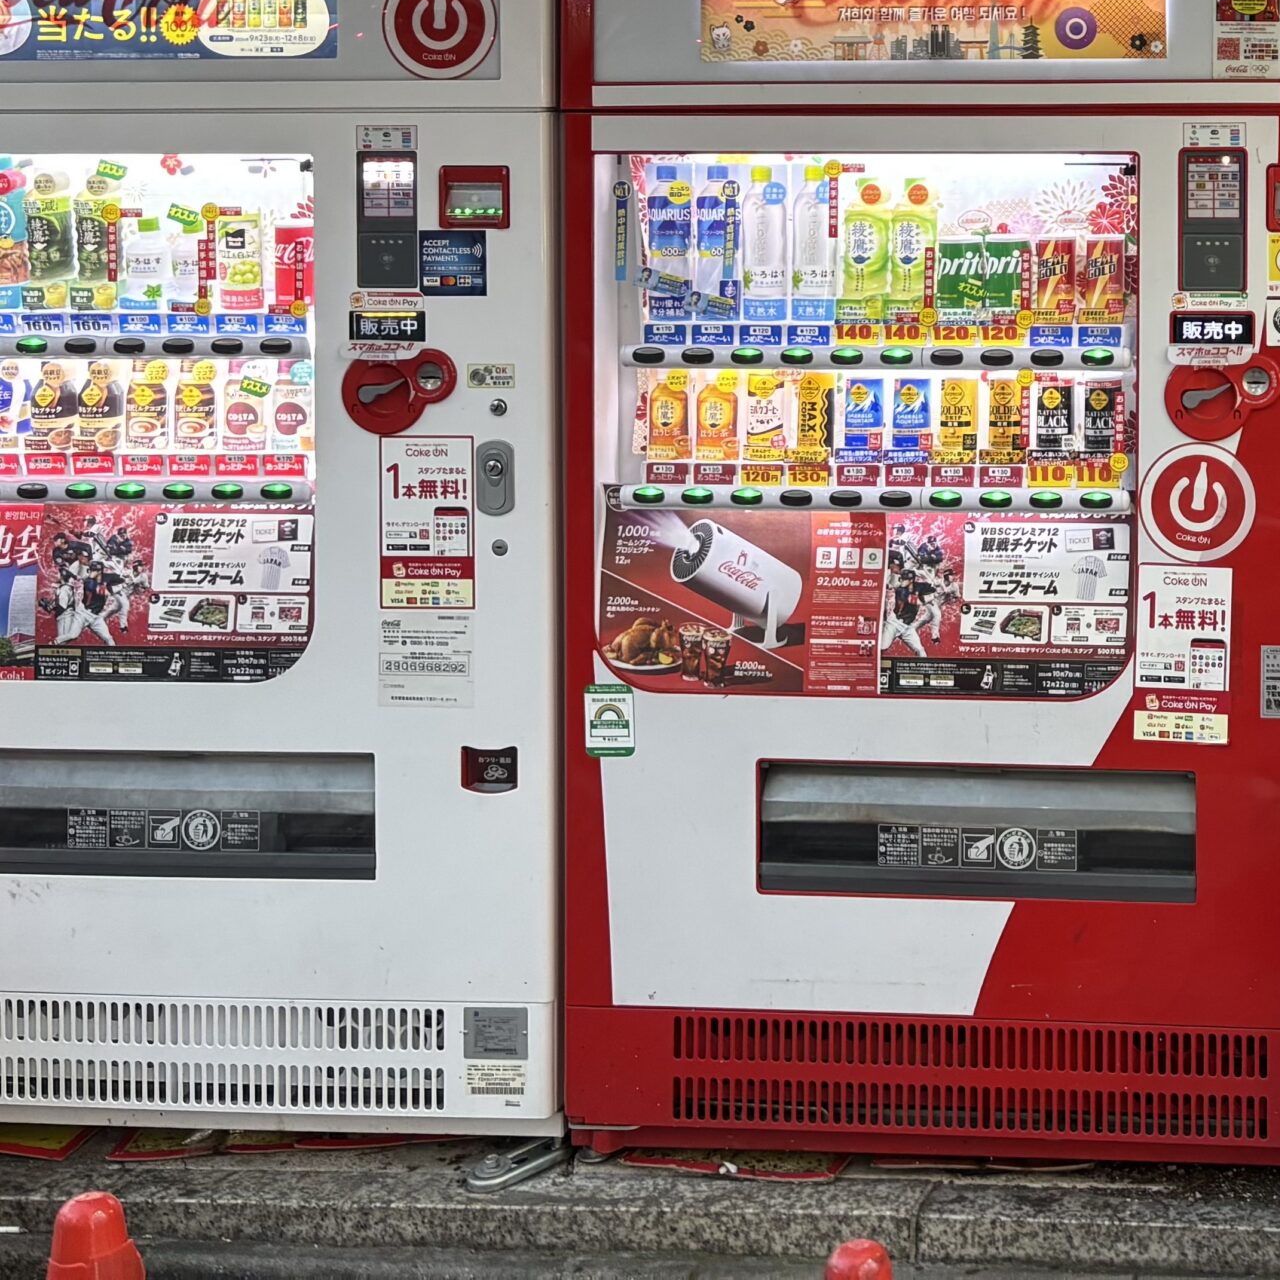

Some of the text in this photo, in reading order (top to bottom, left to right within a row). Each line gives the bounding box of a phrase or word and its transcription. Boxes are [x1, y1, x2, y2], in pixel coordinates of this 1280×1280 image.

[837, 8, 876, 22] 저희와
[878, 8, 905, 22] 함께
[909, 8, 948, 22] 즐거운
[951, 8, 976, 22] 여행
[37, 5, 157, 42] 当たる!!
[422, 52, 444, 61] Coke
[851, 222, 869, 255] 綾鷹
[898, 222, 916, 255] 綾鷹
[1039, 255, 1067, 271] REAL
[1088, 255, 1116, 270] REAL
[1039, 264, 1068, 280] GOLD
[1088, 264, 1116, 280] GOLD
[367, 298, 388, 307] Coke
[402, 298, 418, 309] Pay
[1191, 299, 1209, 308] Coke
[1219, 299, 1232, 309] Pay
[25, 321, 60, 331] 160円
[72, 321, 110, 331] 160円
[360, 319, 418, 335] 販売中
[836, 325, 879, 340] 140円
[885, 325, 927, 340] 140円
[933, 325, 977, 340] 120円
[981, 325, 1025, 340] 120円
[1182, 321, 1243, 340] 販売中
[807, 401, 817, 433] MAX
[1038, 415, 1068, 428] BLACK
[653, 429, 681, 437] ほうじ茶
[701, 429, 729, 438] ほうじ茶
[405, 448, 432, 457] Coke
[386, 463, 467, 500] 1本無料!
[744, 472, 779, 482] 120円
[790, 472, 827, 482] 130円
[1030, 466, 1072, 482] 110円
[171, 529, 245, 544] 観戦チケット
[981, 527, 1059, 535] WBSCプレミア12
[1176, 533, 1197, 543] Coke
[981, 537, 1058, 553] 観戦チケット
[168, 570, 244, 586] ユニフォーム
[407, 567, 430, 576] Coke
[445, 567, 461, 578] Pay
[719, 560, 764, 591] Coca-Cola
[979, 580, 1058, 596] ユニフォーム
[1163, 576, 1189, 586] Coke
[1176, 596, 1226, 606] スタンプたまると
[1143, 591, 1226, 632] 1本無料!
[1161, 700, 1184, 709] Coke
[1199, 702, 1216, 712] Pay
